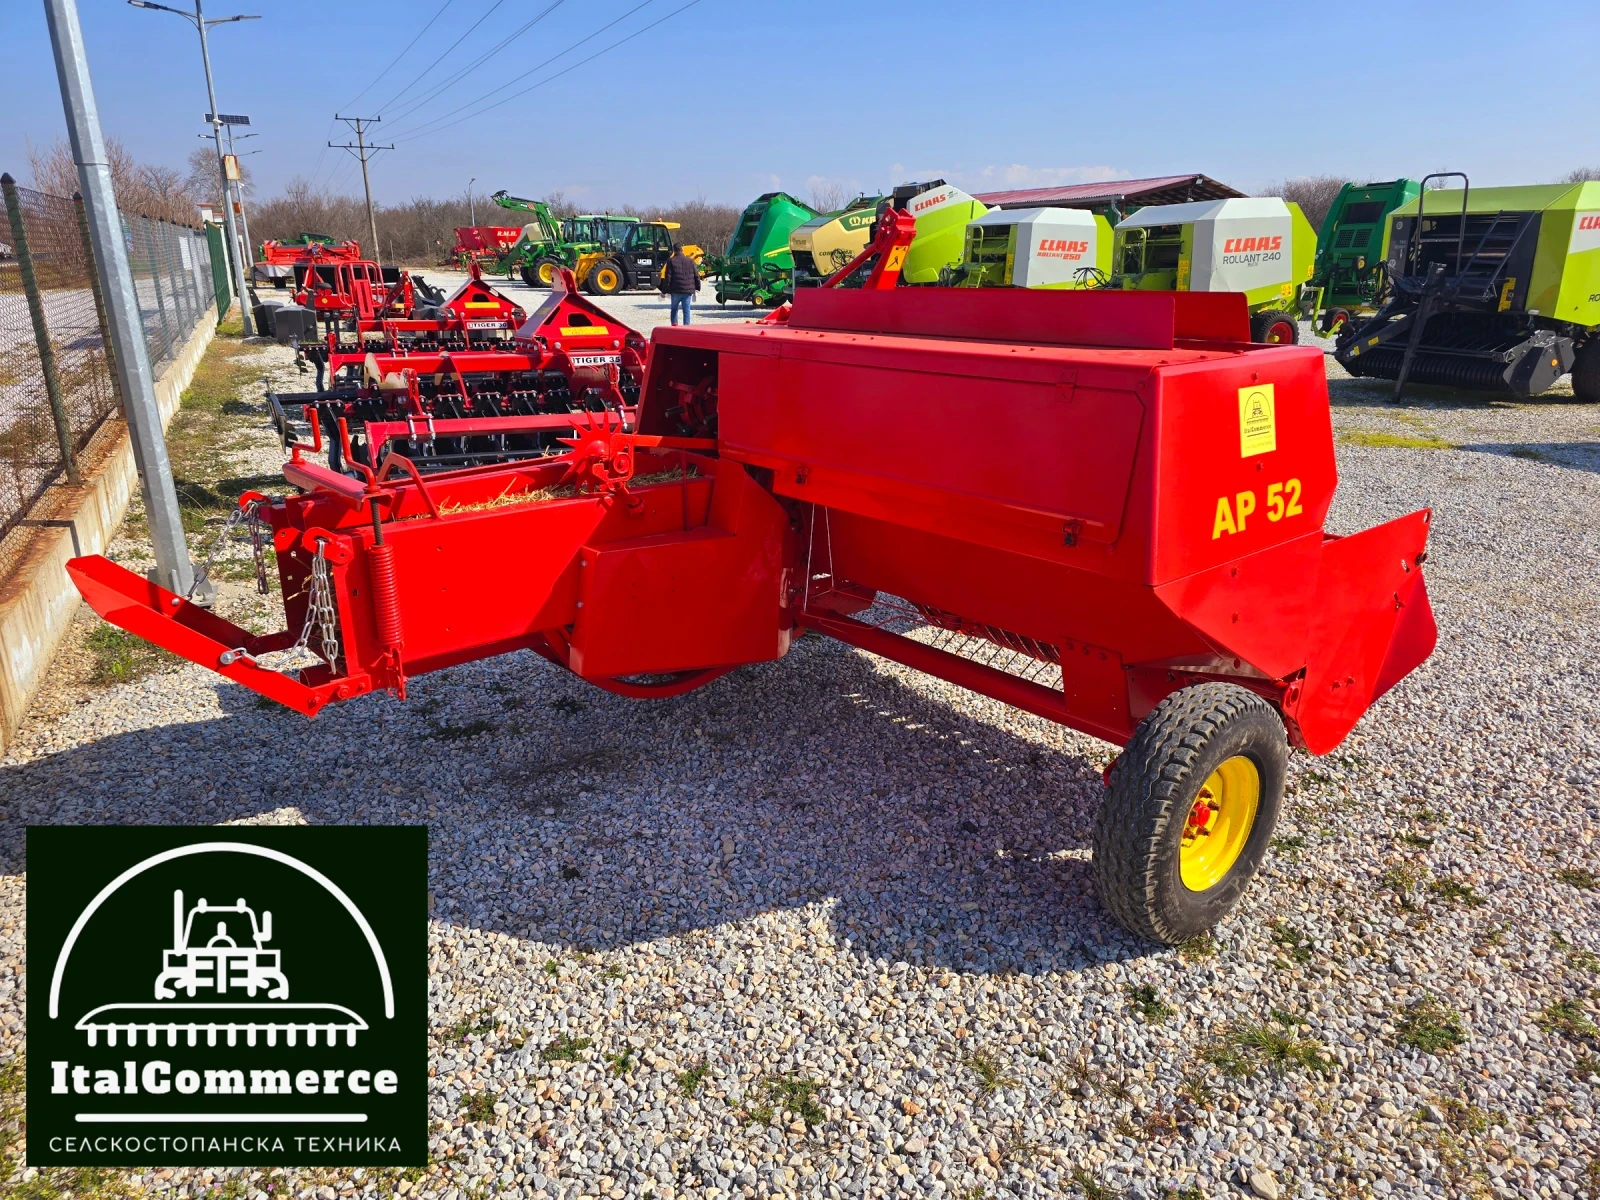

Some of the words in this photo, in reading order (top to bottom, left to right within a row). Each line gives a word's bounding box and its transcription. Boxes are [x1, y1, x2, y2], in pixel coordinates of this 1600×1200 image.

[914, 193, 946, 212] CLAAS
[1039, 239, 1089, 252] CLAAS
[1223, 235, 1282, 253] CLAAS
[1222, 253, 1261, 265] ROLLANT
[1262, 251, 1281, 262] 240
[575, 356, 606, 364] TIGER
[608, 355, 621, 363] 35
[1212, 490, 1256, 540] AP
[1266, 478, 1303, 523] 52
